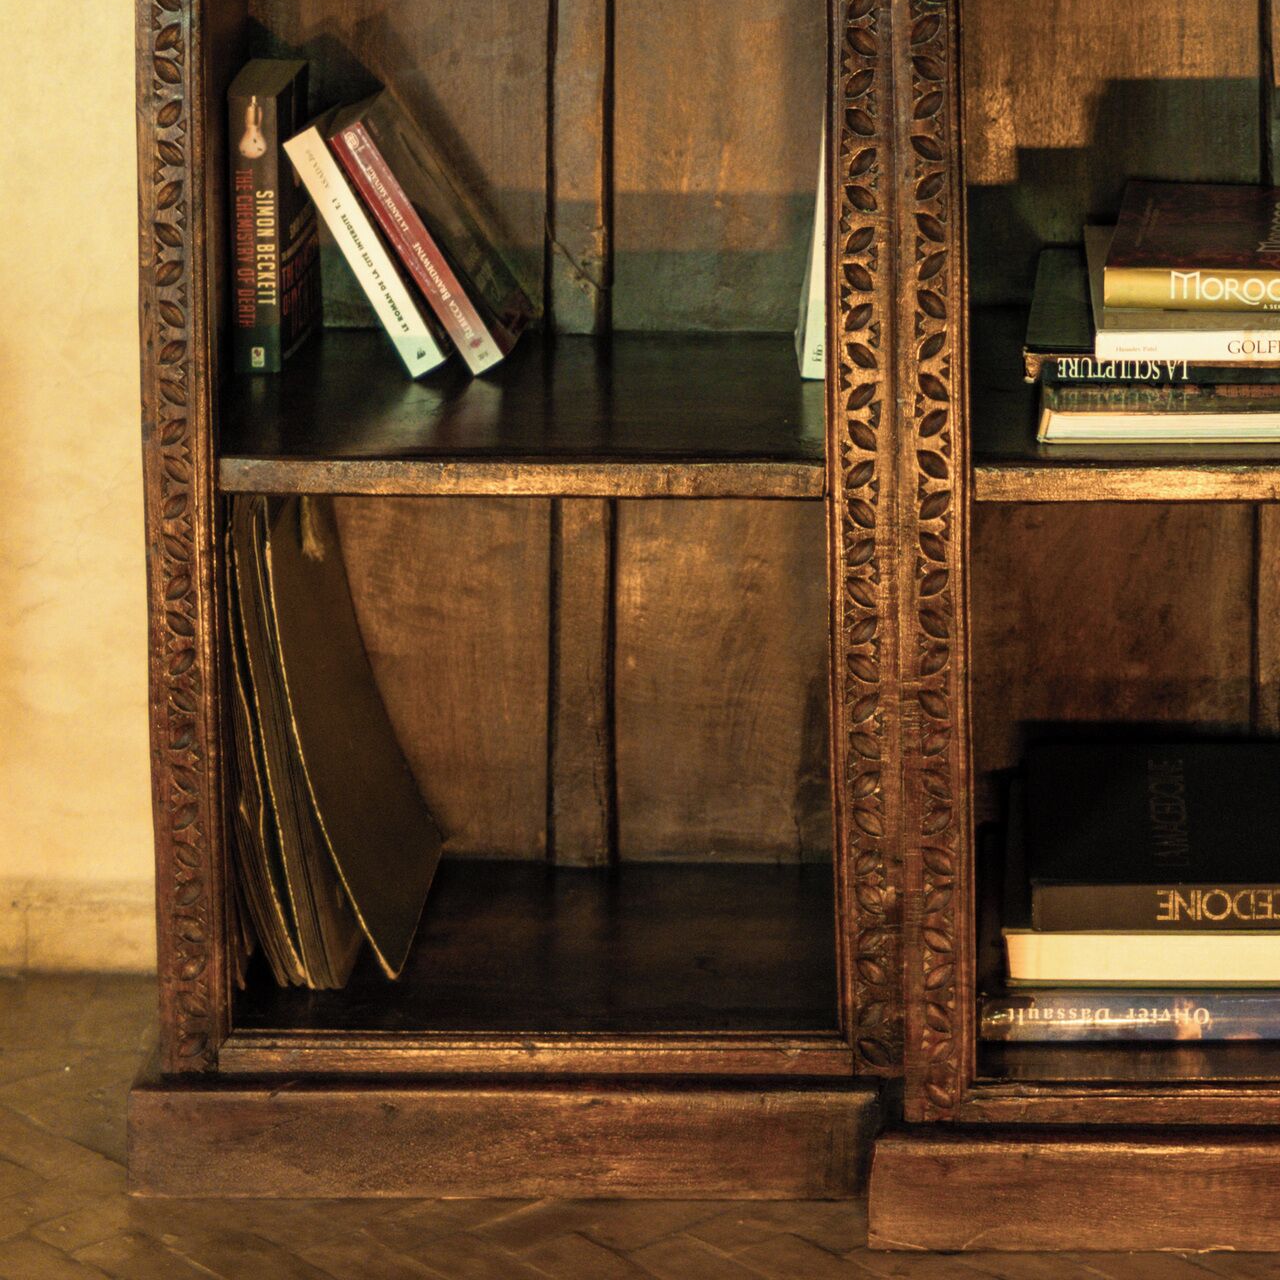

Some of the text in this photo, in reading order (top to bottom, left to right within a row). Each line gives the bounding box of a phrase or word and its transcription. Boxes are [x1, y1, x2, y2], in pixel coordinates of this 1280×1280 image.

[235, 168, 257, 328] THE CHEMISTRY OF DEATH
[255, 190, 277, 306] SIMON BECKETT
[411, 242, 475, 340] REBECCA BRANDEWYNE
[1057, 357, 1190, 380] LA SCULPTURE
[1008, 1006, 1210, 1026] Olivier Dassault
